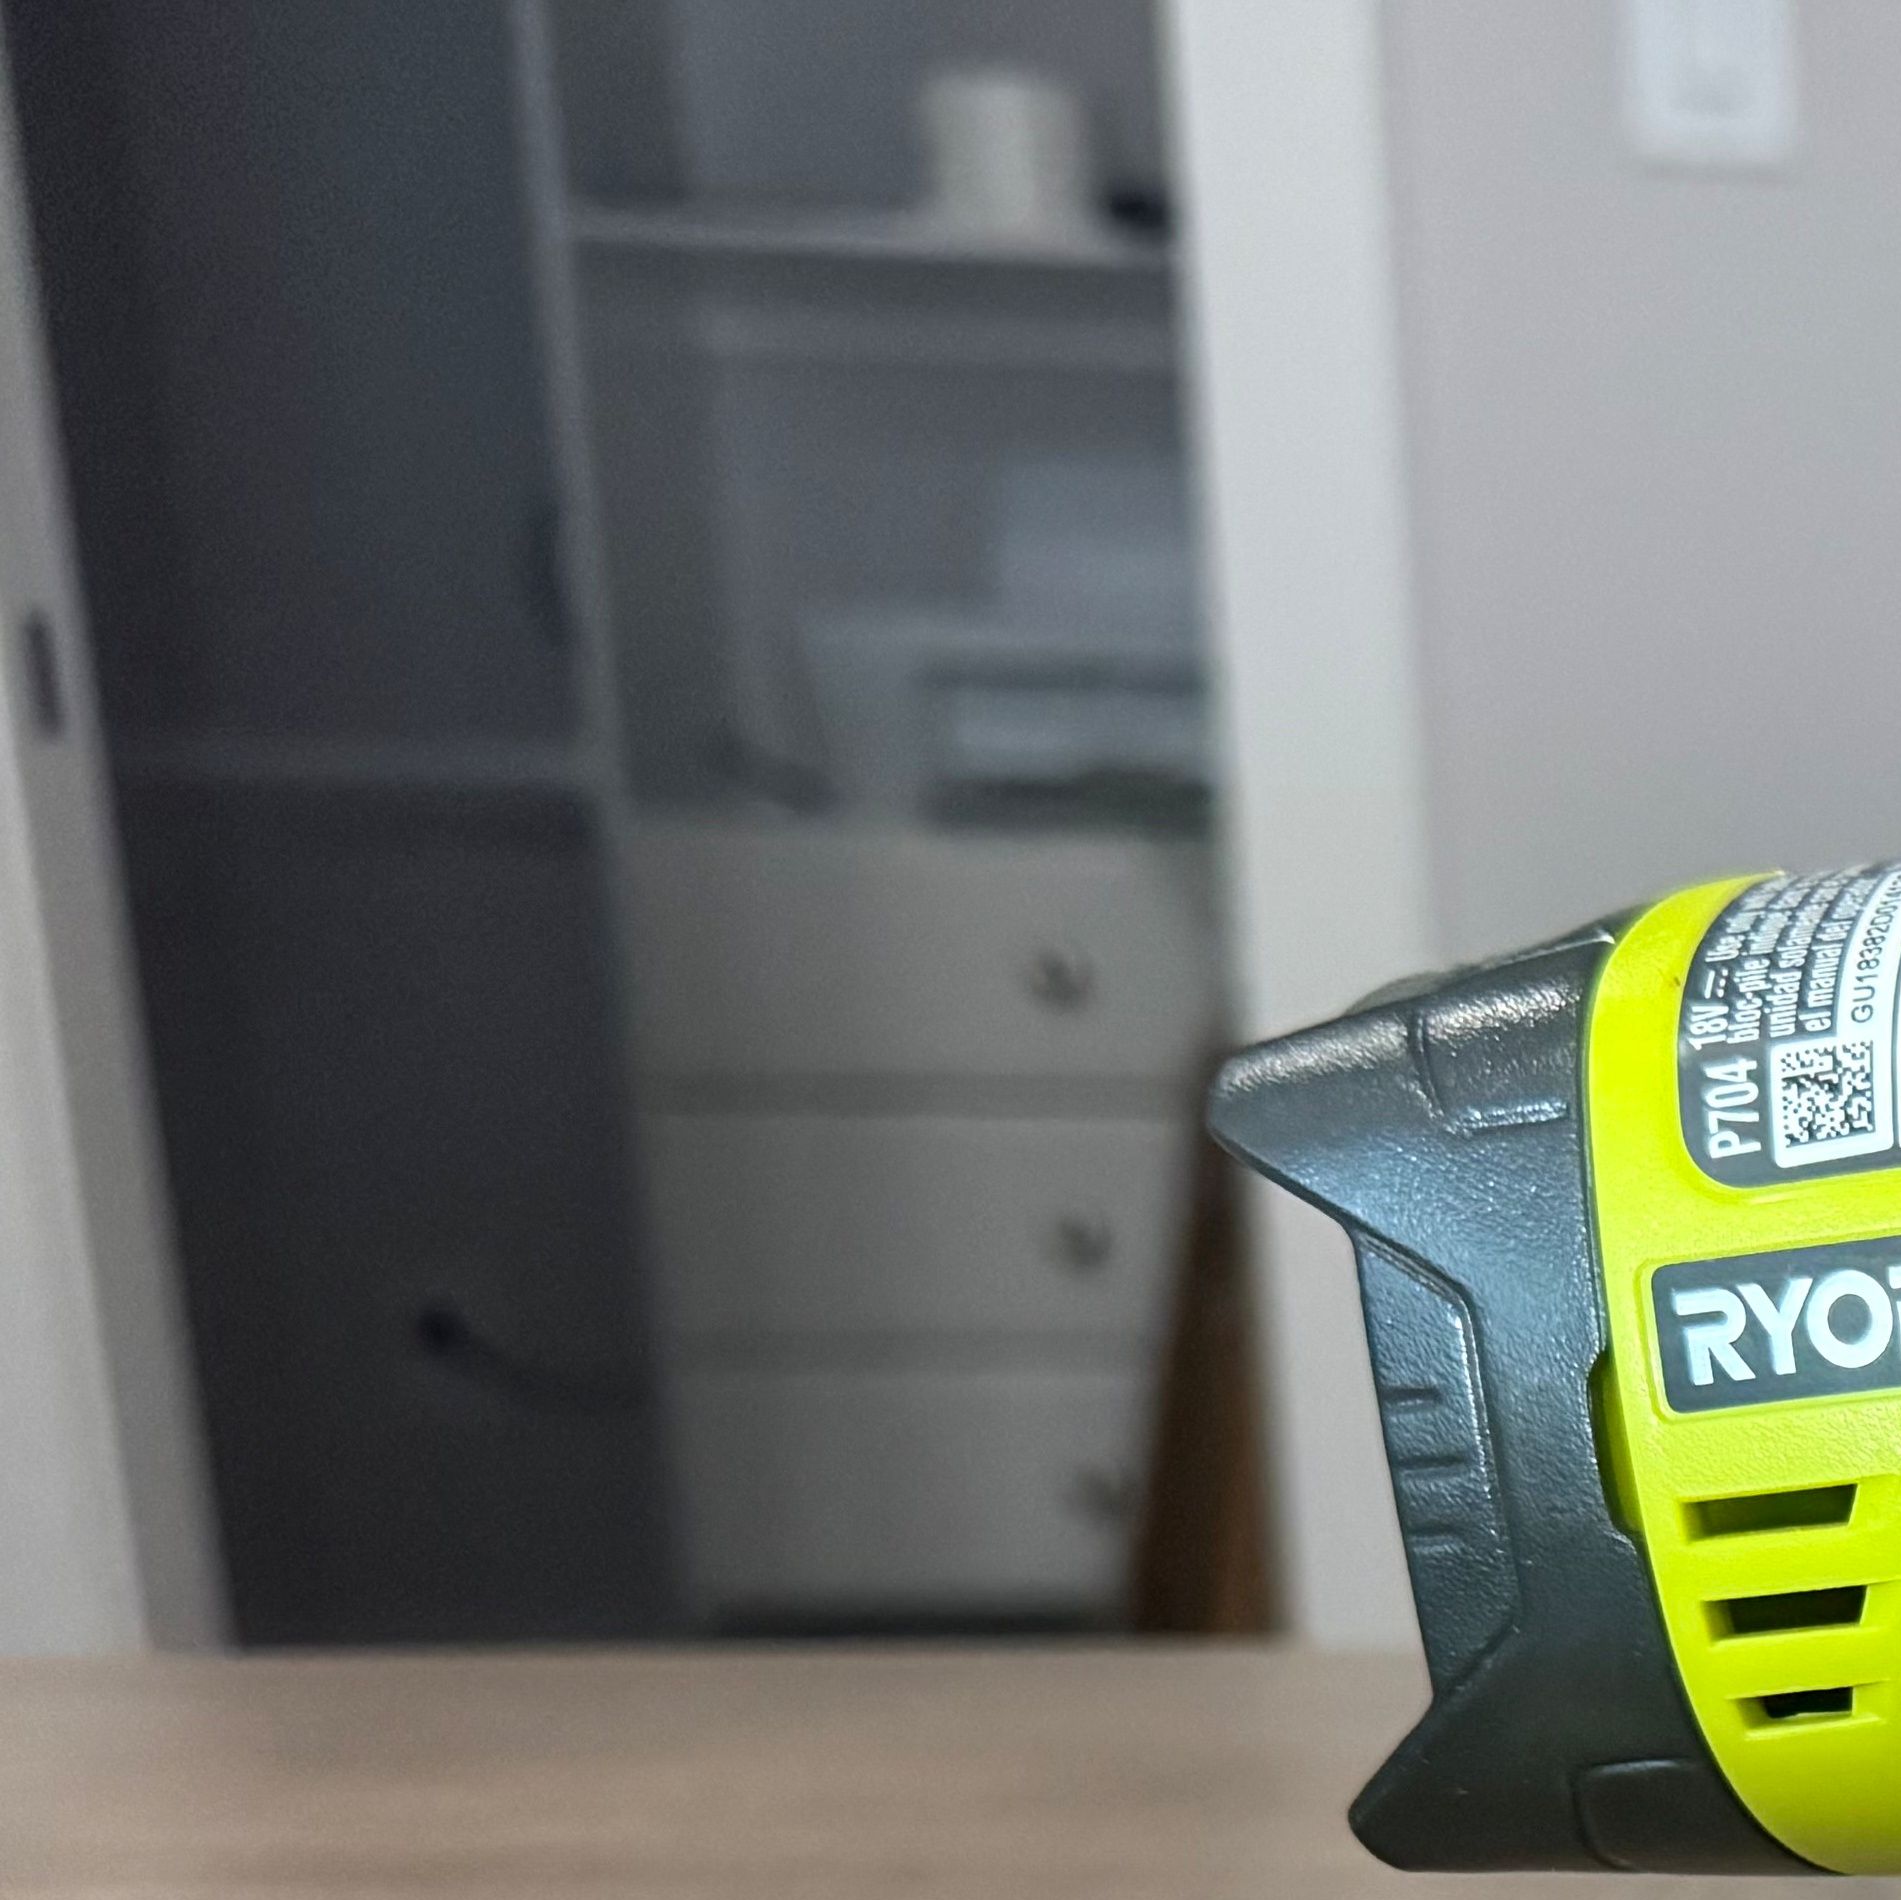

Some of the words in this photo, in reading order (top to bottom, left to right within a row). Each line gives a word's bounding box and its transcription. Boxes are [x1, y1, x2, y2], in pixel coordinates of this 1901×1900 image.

[1815, 920, 1853, 942] del
[1727, 957, 1772, 1043] bloc-pile
[1764, 970, 1802, 1038] unidad
[1807, 943, 1844, 1008] manual
[1688, 1005, 1729, 1051] 18V
[1799, 1010, 1833, 1032] el
[1704, 1058, 1762, 1160] P704
